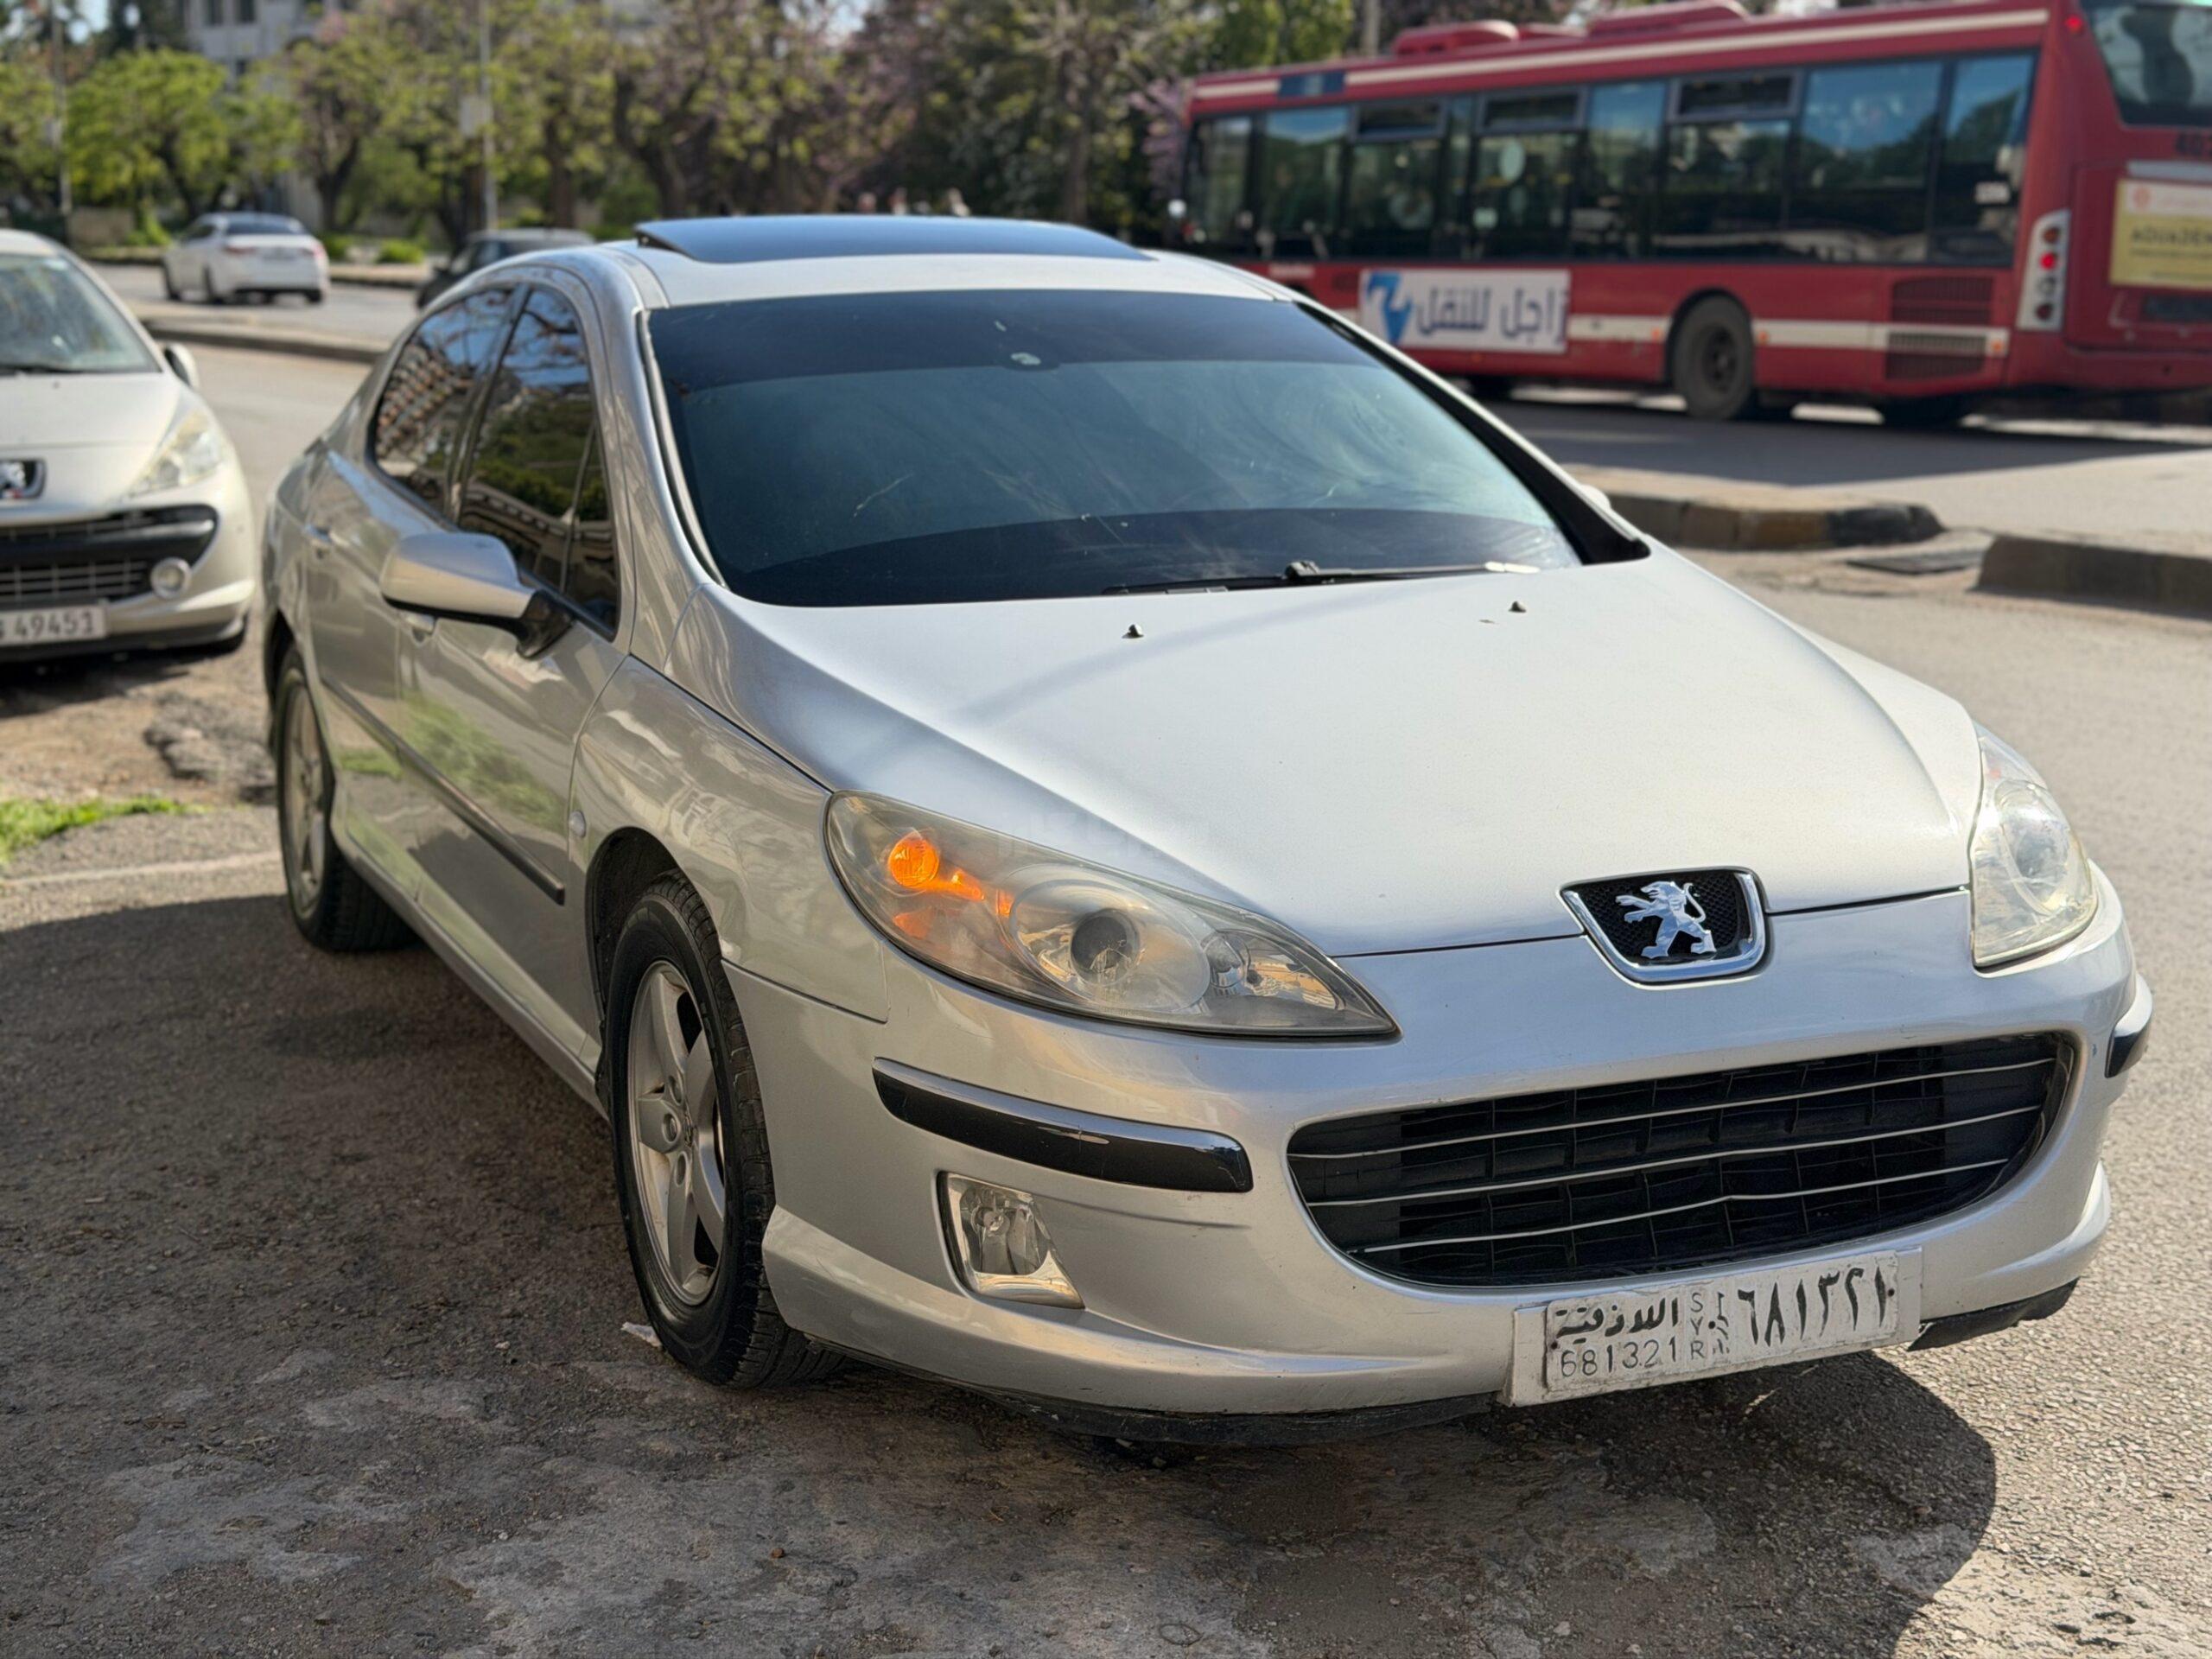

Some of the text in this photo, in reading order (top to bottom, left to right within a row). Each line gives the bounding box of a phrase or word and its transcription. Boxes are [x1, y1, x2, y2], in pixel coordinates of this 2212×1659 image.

[1416, 287, 1491, 337] للنقل
[1690, 1292, 1706, 1360] SYR
[1738, 1266, 1887, 1347] ٦٨١٣٢١
[1561, 1336, 1677, 1377] 681321
